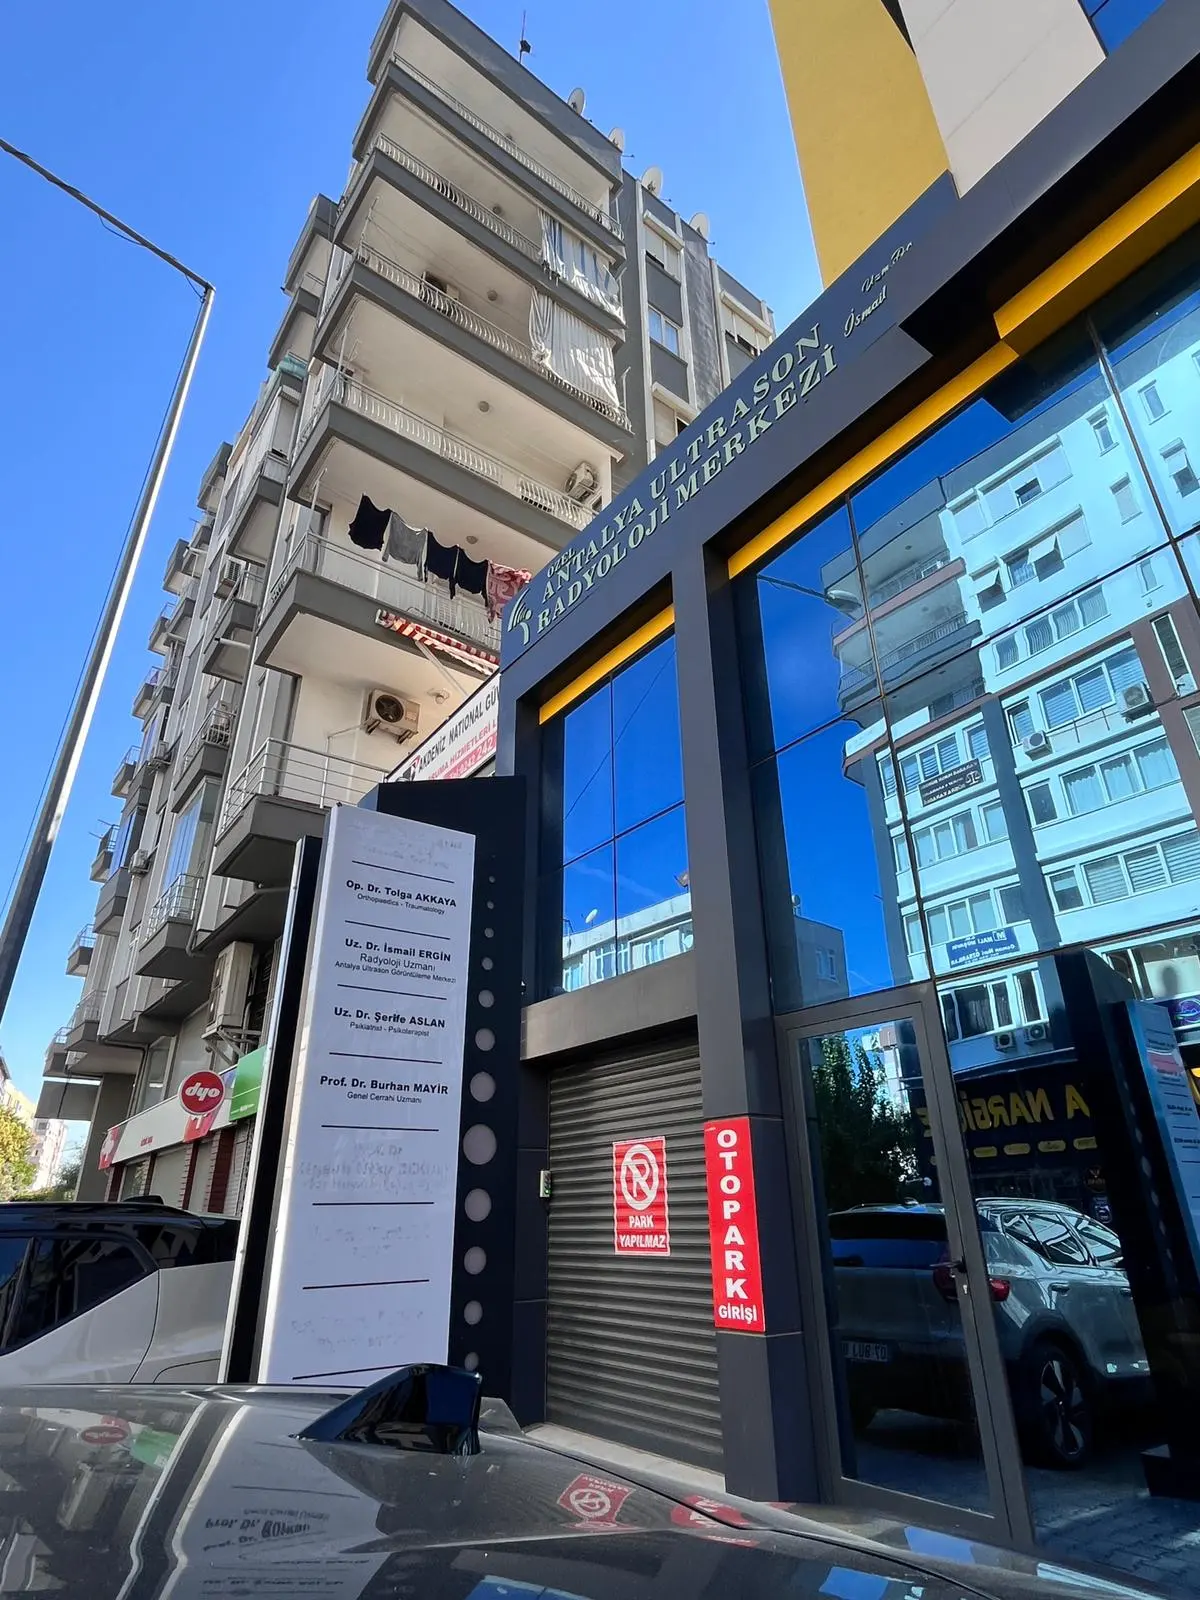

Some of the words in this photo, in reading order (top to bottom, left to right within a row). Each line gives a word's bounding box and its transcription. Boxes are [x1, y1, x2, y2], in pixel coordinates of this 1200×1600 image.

[542, 498, 644, 603] ANTALYA
[650, 323, 820, 499] ULTRASON
[537, 496, 670, 633] RADYOLOJİ
[676, 344, 838, 509] MERKEZİ
[449, 703, 483, 745] NATIONAL
[346, 880, 364, 891] Op.
[367, 883, 381, 894] Dr.
[385, 887, 412, 900] Tolga
[415, 893, 456, 907] AKKAYA
[345, 938, 362, 949] Uz.
[366, 941, 380, 952] Dr.
[384, 942, 415, 957] İsmail
[419, 949, 451, 961] ERGİN
[360, 953, 400, 968] Radyoloji
[335, 960, 361, 971] Antalya
[362, 965, 390, 975] Ultrason
[334, 1006, 352, 1018] Uz.
[356, 1009, 370, 1020] Dr.
[375, 1011, 407, 1024] Şerife
[409, 1016, 446, 1028] ASLAN
[185, 1082, 220, 1101] dyo
[320, 1075, 347, 1088] Prof.
[351, 1078, 367, 1089] Dr.
[370, 1080, 410, 1092] Burhan
[413, 1083, 449, 1095] MAYİR
[347, 1091, 369, 1101] Genel
[370, 1093, 395, 1103] Cerrahi
[629, 1214, 654, 1229] PARK
[717, 1129, 748, 1300] OTOPARK
[619, 1234, 666, 1249] YAPILMAZ
[718, 1303, 757, 1325] GİRİŞİ
